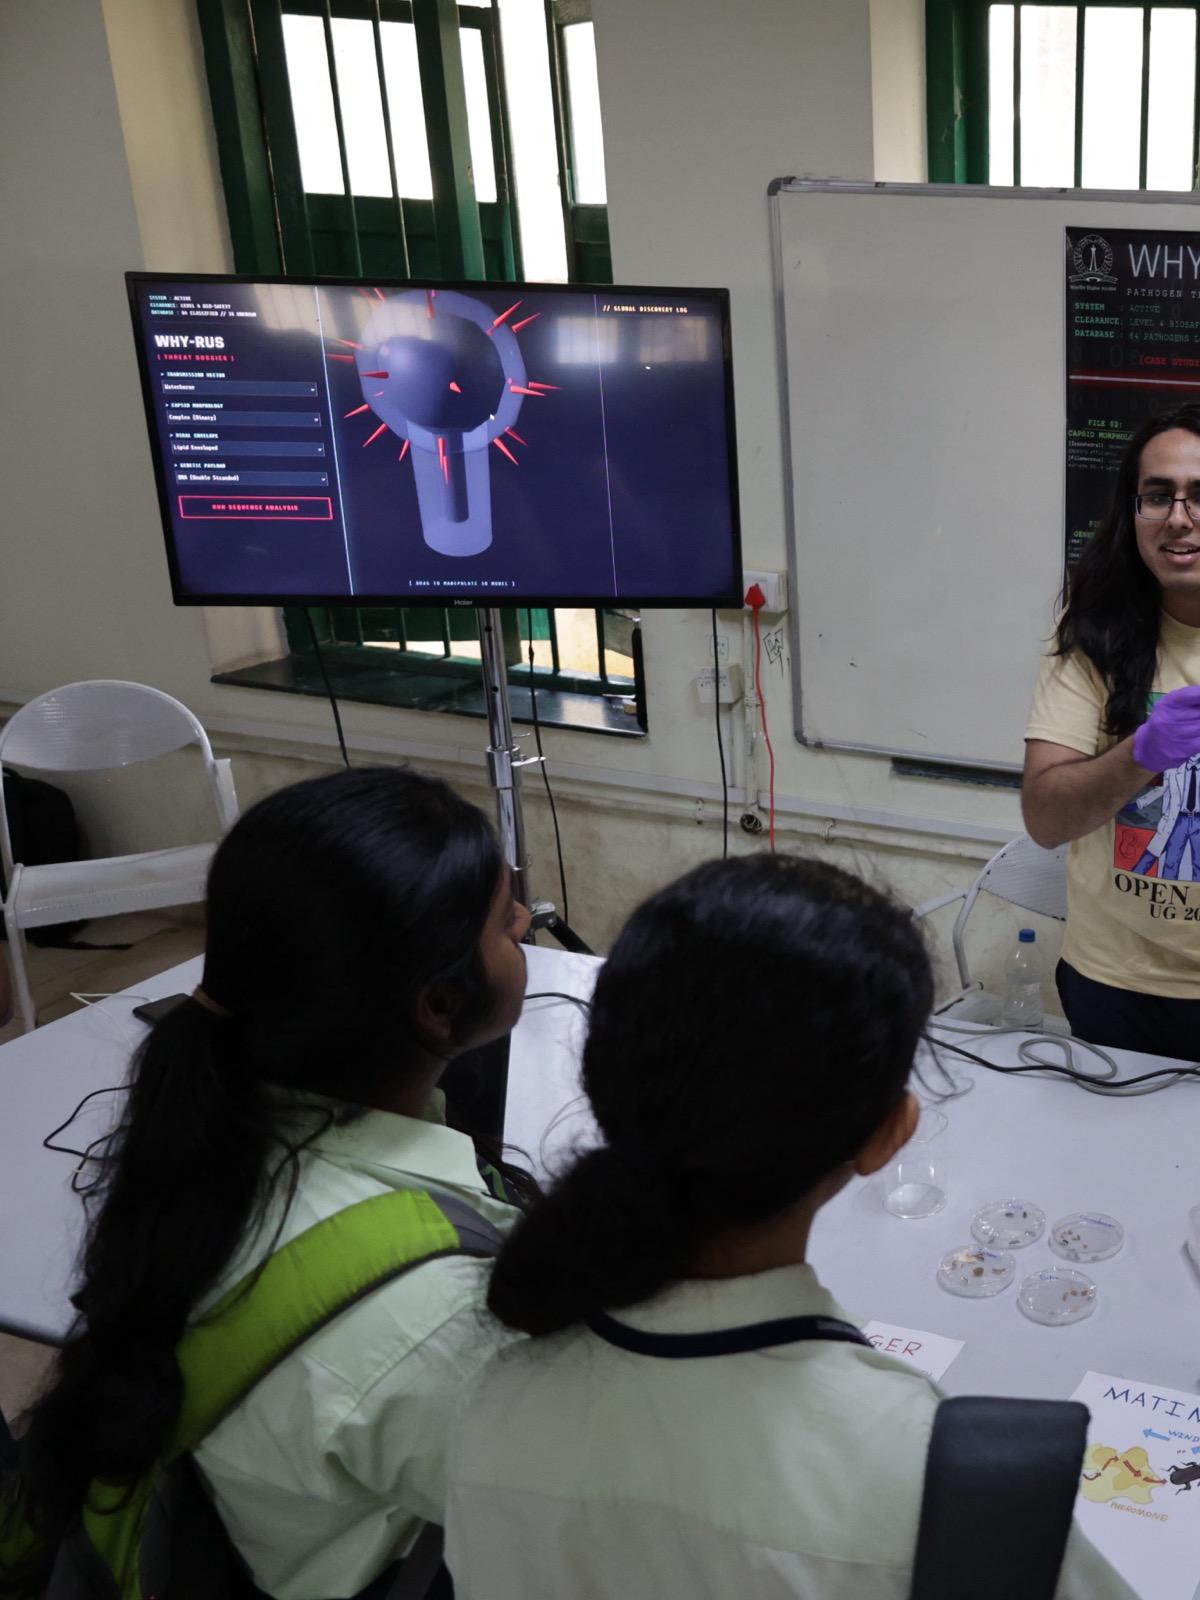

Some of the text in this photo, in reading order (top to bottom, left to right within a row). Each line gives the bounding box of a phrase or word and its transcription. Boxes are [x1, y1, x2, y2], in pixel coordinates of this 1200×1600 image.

[1126, 288, 1182, 298] PATHOGEN
[1129, 305, 1160, 313] ACTIVE
[1129, 318, 1153, 327] LEVEL
[154, 334, 225, 348] WHY-RUS
[1074, 330, 1115, 338] DATABASE
[1143, 333, 1190, 342] PATHOGENS
[1114, 872, 1190, 906] OPEN
[1149, 903, 1176, 920] UG
[868, 1334, 922, 1356] GER
[1168, 1429, 1200, 1442] WIND
[1110, 1502, 1168, 1522] PHEROMONE
